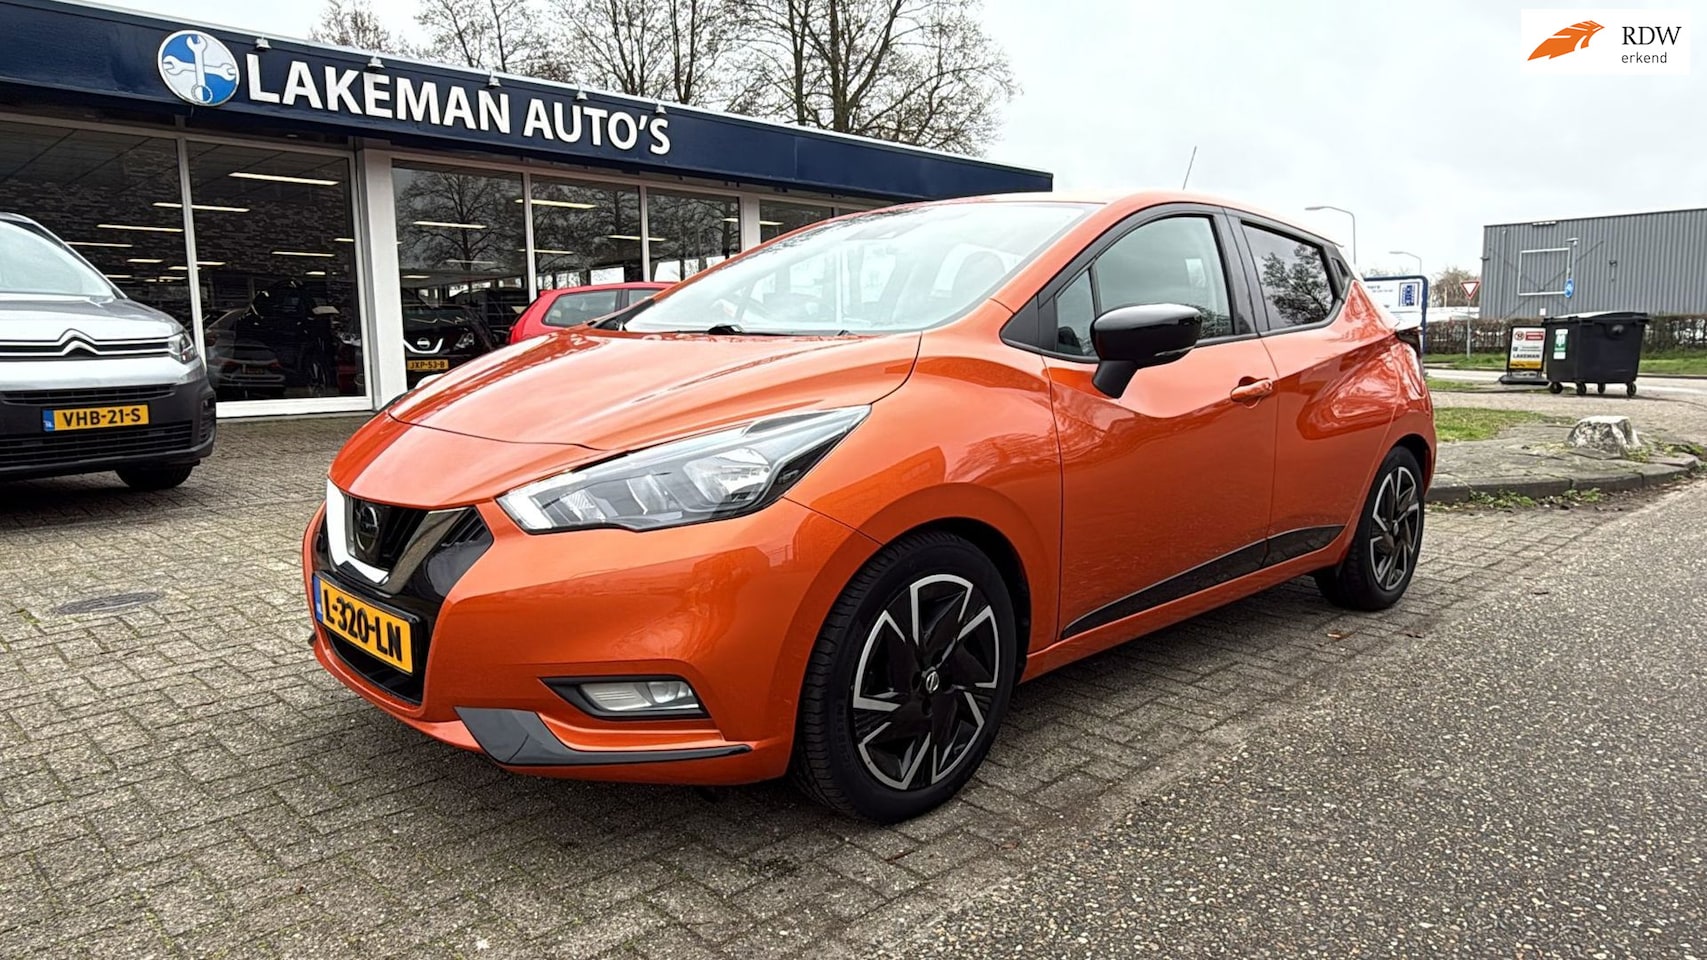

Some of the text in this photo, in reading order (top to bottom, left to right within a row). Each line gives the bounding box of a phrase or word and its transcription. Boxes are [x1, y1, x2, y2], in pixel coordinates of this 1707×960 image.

[246, 53, 672, 156] LAKEMAN AUTO'S
[62, 408, 142, 427] VHB-21-S
[323, 589, 403, 663] L-320-LN
